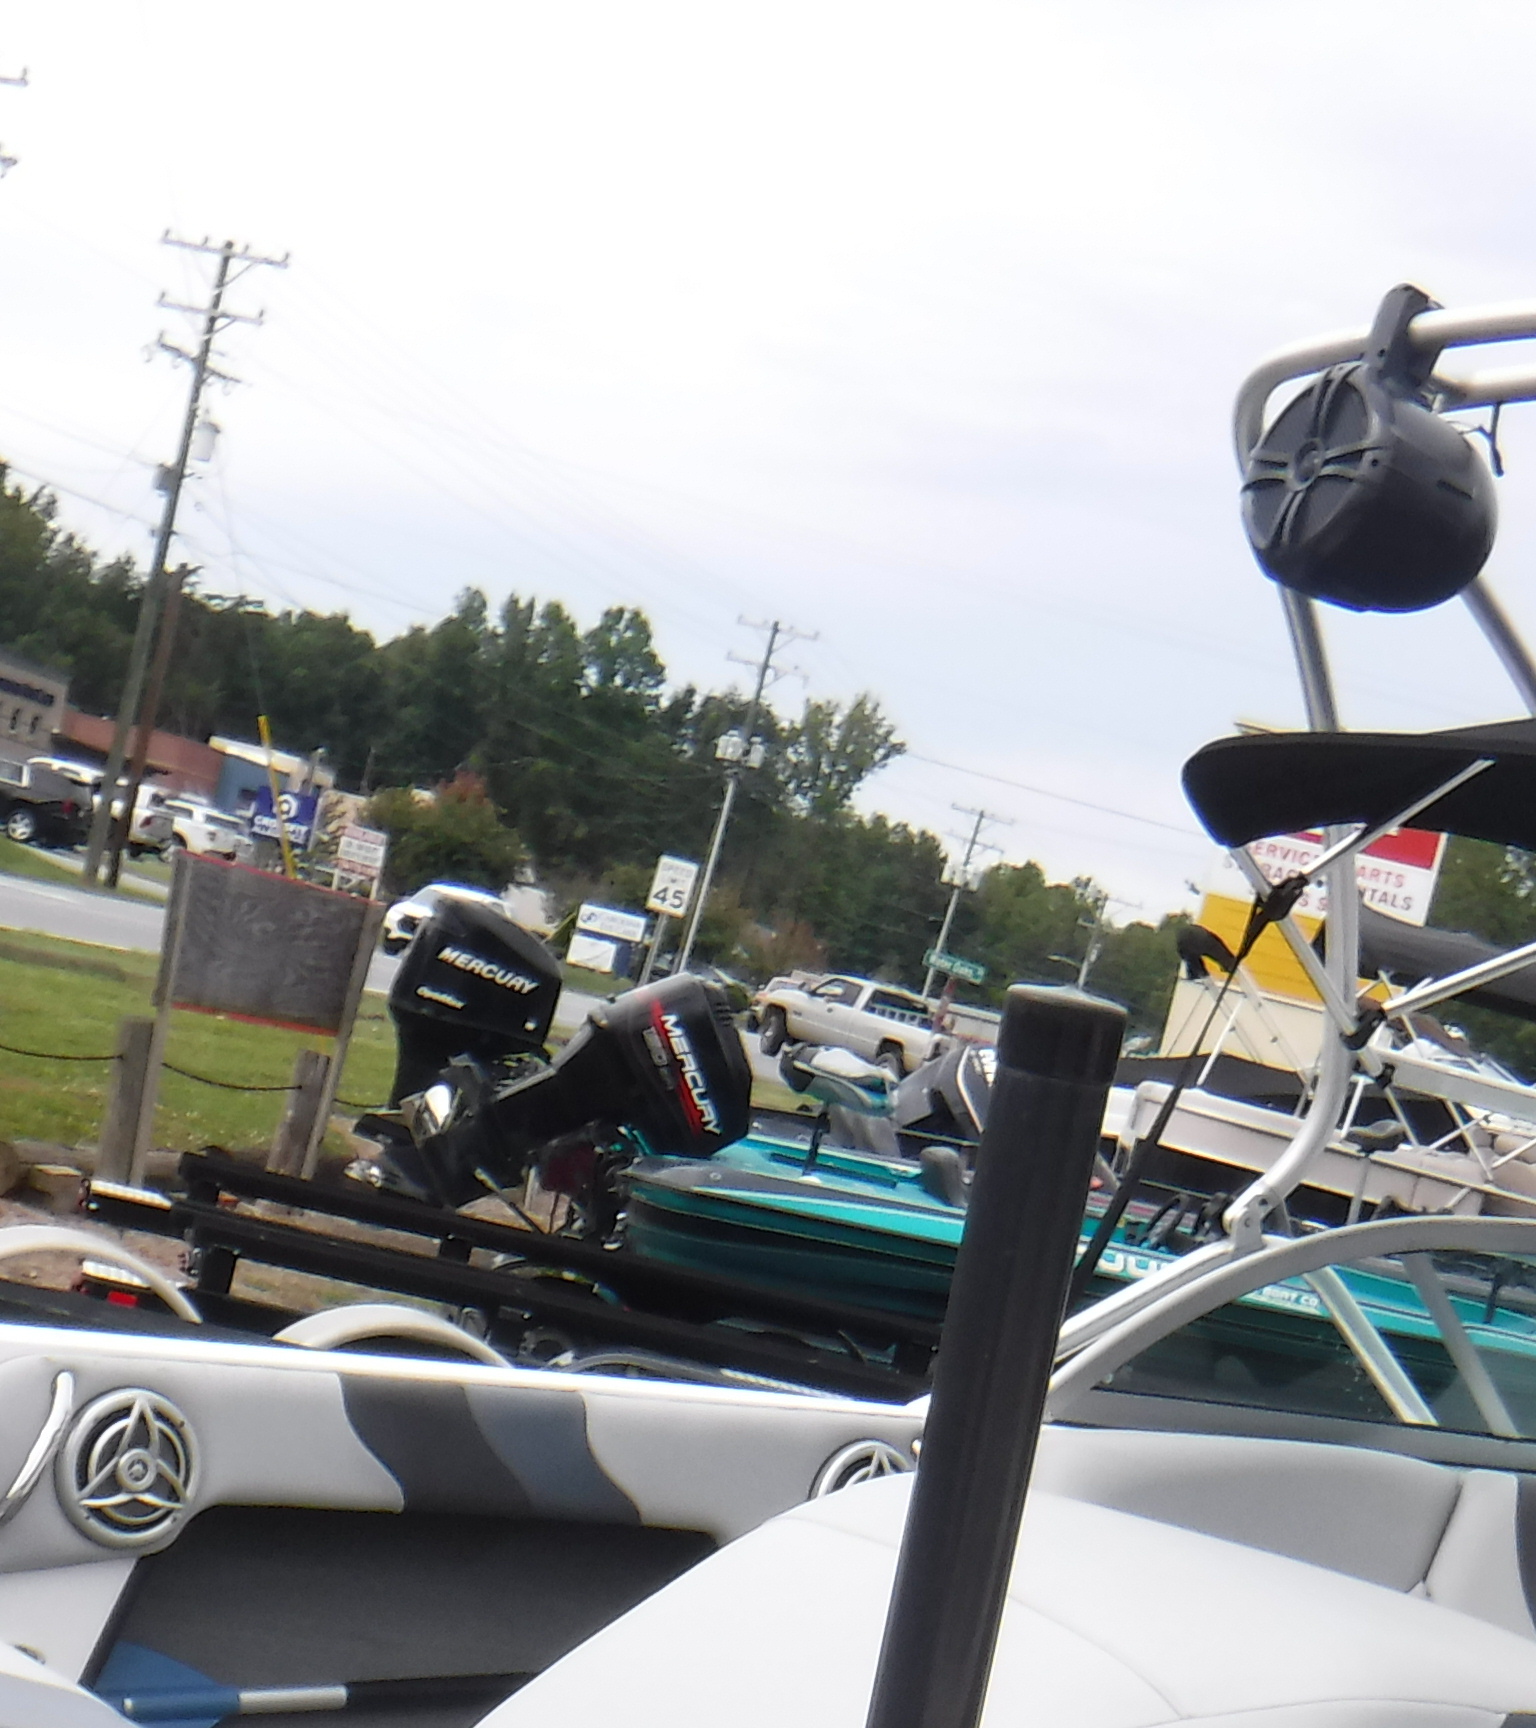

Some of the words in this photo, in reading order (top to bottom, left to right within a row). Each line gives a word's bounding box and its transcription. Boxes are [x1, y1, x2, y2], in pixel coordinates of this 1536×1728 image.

[1357, 864, 1405, 888] ARTS
[653, 887, 685, 909] 45
[437, 947, 540, 995] MERCURY
[660, 1014, 721, 1135] MERCURY
